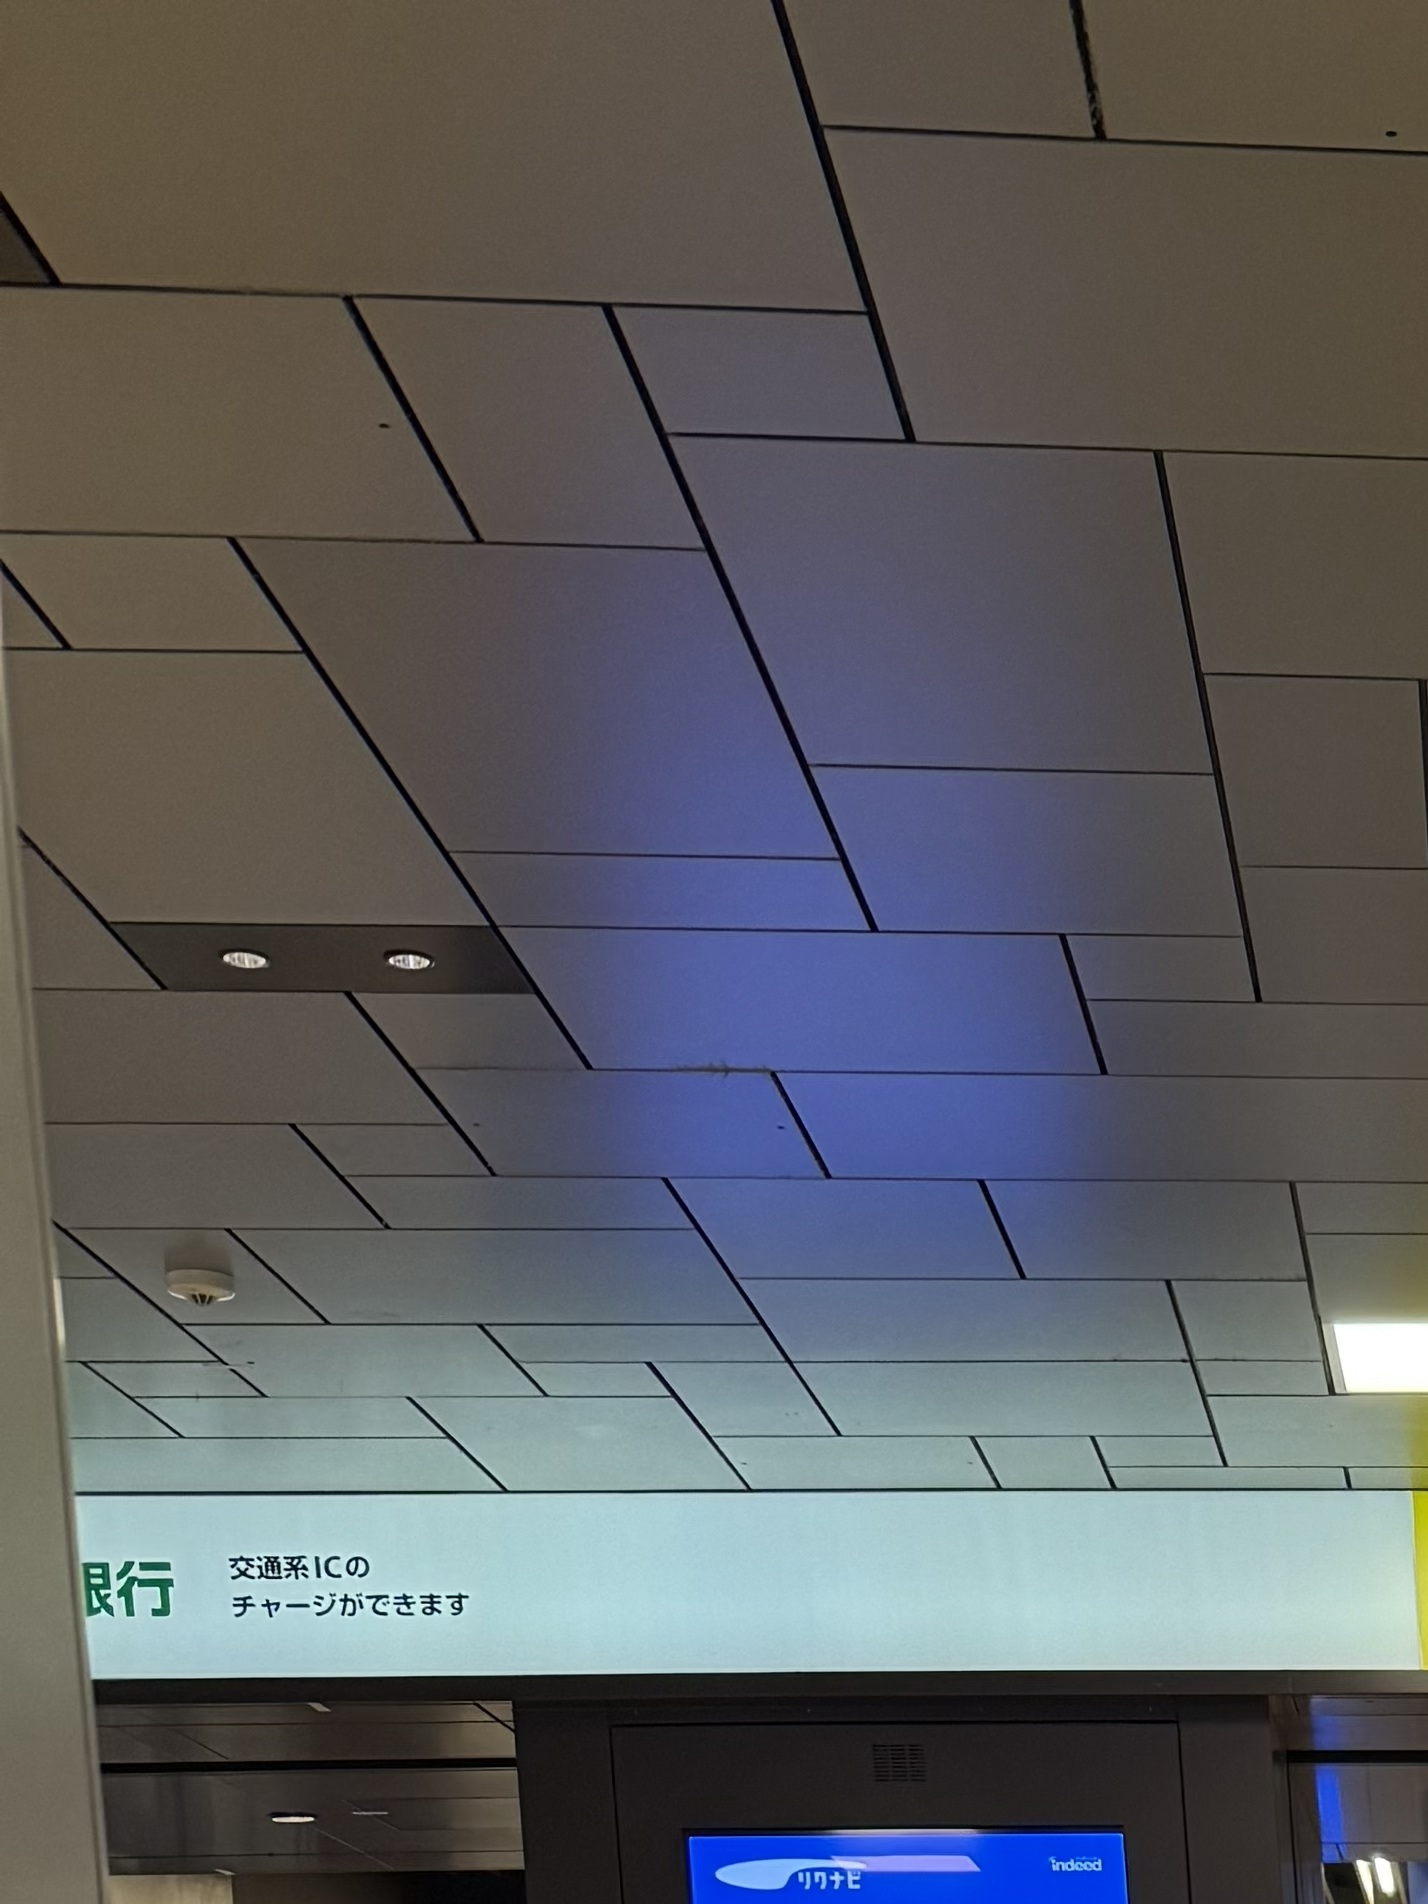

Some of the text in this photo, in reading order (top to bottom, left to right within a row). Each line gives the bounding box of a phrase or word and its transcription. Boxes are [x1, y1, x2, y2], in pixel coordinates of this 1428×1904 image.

[229, 1555, 371, 1581] 交通系ICの
[232, 1593, 469, 1618] チャージができます
